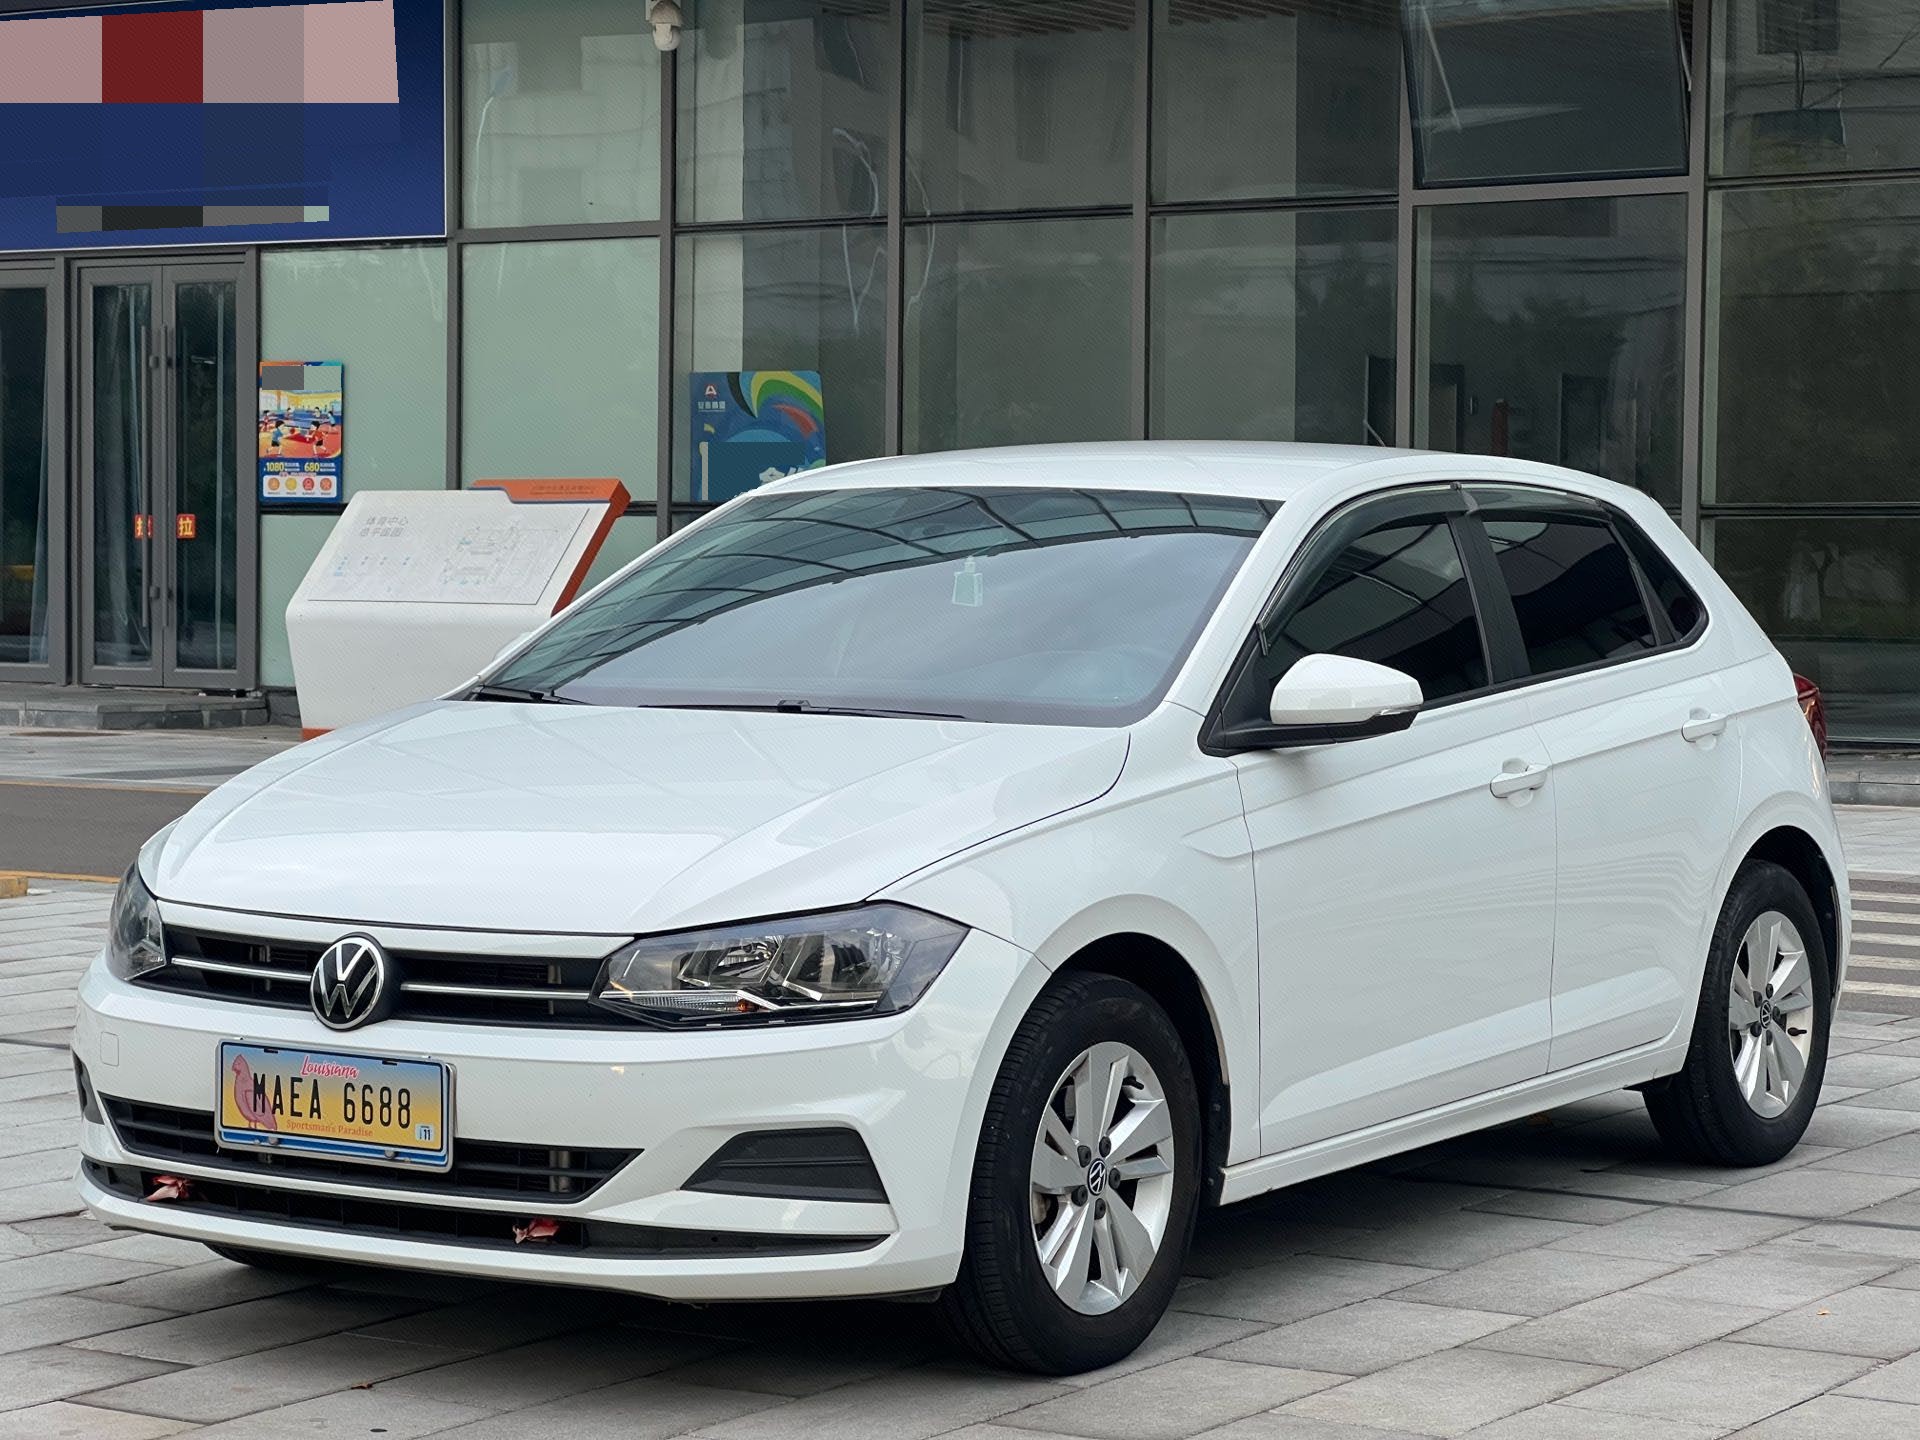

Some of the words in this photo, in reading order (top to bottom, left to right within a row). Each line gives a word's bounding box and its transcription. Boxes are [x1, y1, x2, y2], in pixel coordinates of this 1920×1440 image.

[266, 461, 284, 472] 1080
[304, 461, 320, 472] 680
[178, 517, 193, 536] 拉
[300, 1056, 359, 1080] Louisiana
[253, 1072, 322, 1119] MAEA
[343, 1082, 411, 1129] 6688
[286, 1119, 336, 1133] Sportsman's
[338, 1124, 373, 1138] Paradise
